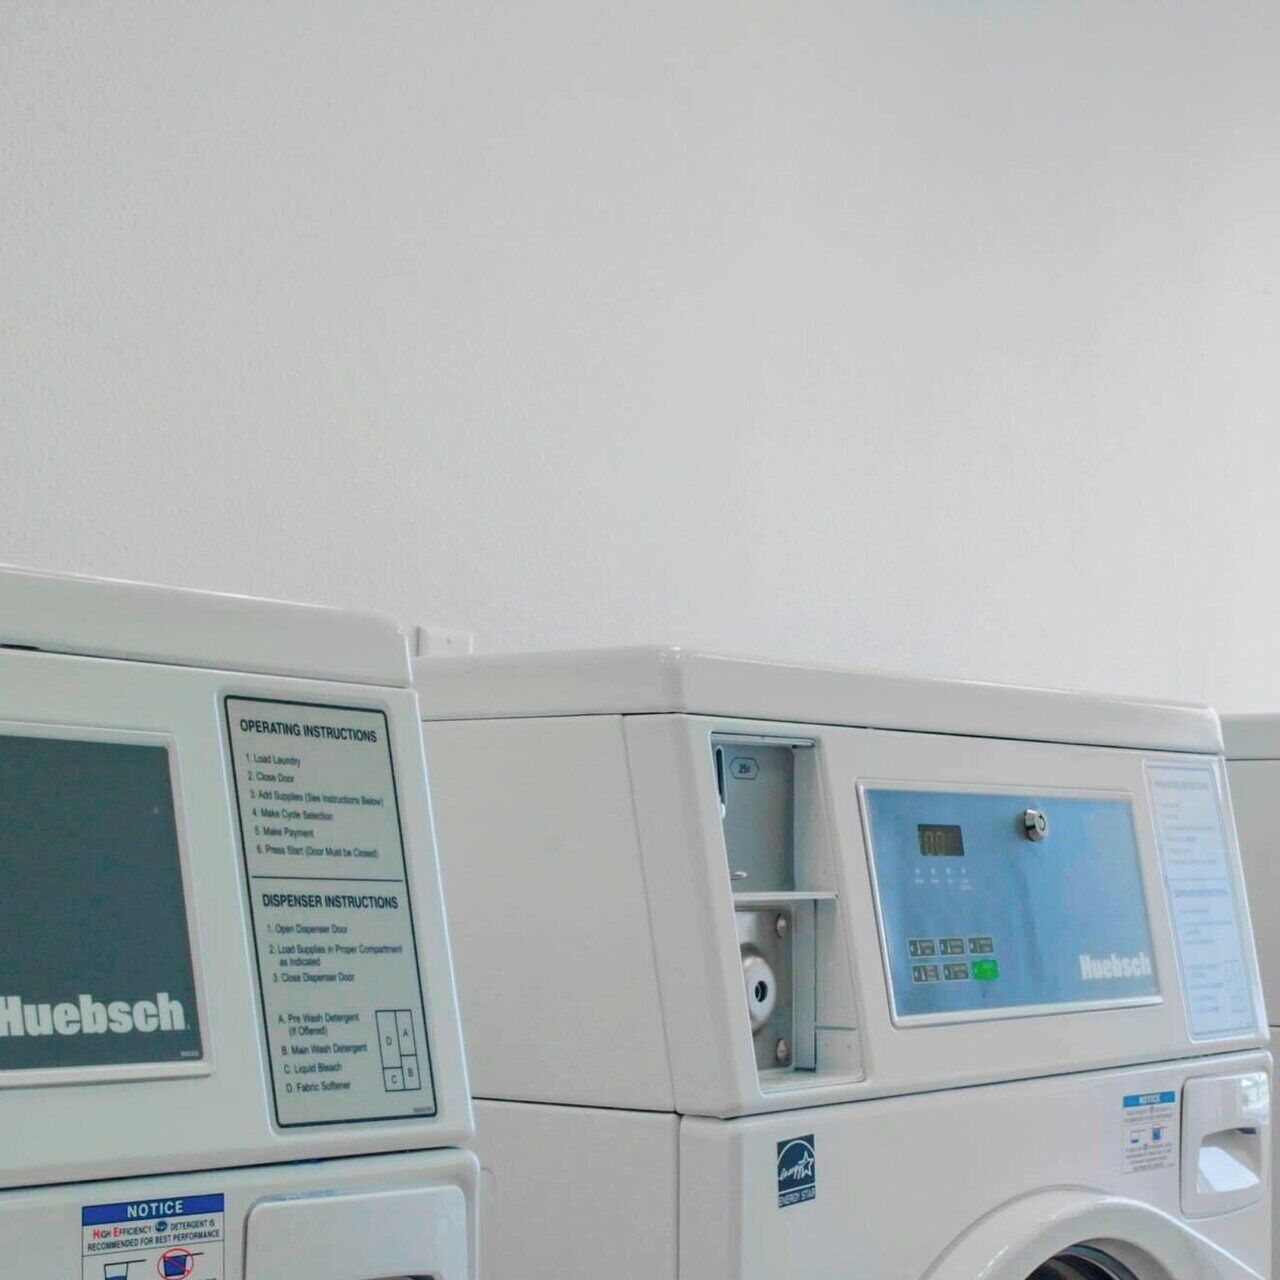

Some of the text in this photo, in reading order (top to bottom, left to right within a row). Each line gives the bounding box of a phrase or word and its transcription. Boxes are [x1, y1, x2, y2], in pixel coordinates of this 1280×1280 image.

[240, 719, 377, 743] OPERATING INSTRUCTIONS
[254, 753, 271, 764] Load
[273, 755, 300, 768] Laundry
[256, 771, 276, 782] Close
[278, 773, 294, 783] Door
[259, 790, 272, 800] Add
[274, 791, 303, 803] Supplies
[261, 808, 279, 818] Make
[284, 828, 314, 839] Payment
[262, 894, 399, 909] DISPENSER INSTRUCTIONS
[275, 924, 295, 936] Open
[296, 924, 329, 936] Dispenser
[331, 924, 347, 934] Door
[278, 945, 295, 955] Load
[1078, 952, 1153, 979] Huebsch
[281, 973, 300, 983] Close
[338, 972, 355, 982] Door
[302, 1014, 323, 1024] Wash
[325, 1013, 359, 1025] Detergent
[403, 1028, 409, 1037] A
[386, 1036, 392, 1046] D
[291, 1046, 310, 1055] Main
[311, 1045, 332, 1054] Wash
[294, 1064, 316, 1076] Liquid
[318, 1063, 342, 1073] Bleach
[408, 1068, 414, 1077] B
[391, 1075, 397, 1084] C
[297, 1082, 319, 1092] Fabric
[127, 1200, 184, 1218] NOTICE
[93, 1228, 111, 1239] HIGH
[113, 1226, 152, 1237] EFFICIENCY
[170, 1220, 207, 1231] DETERGENT
[87, 1229, 220, 1251] RECOMMENDED FOR BEST PERFORMANCE
